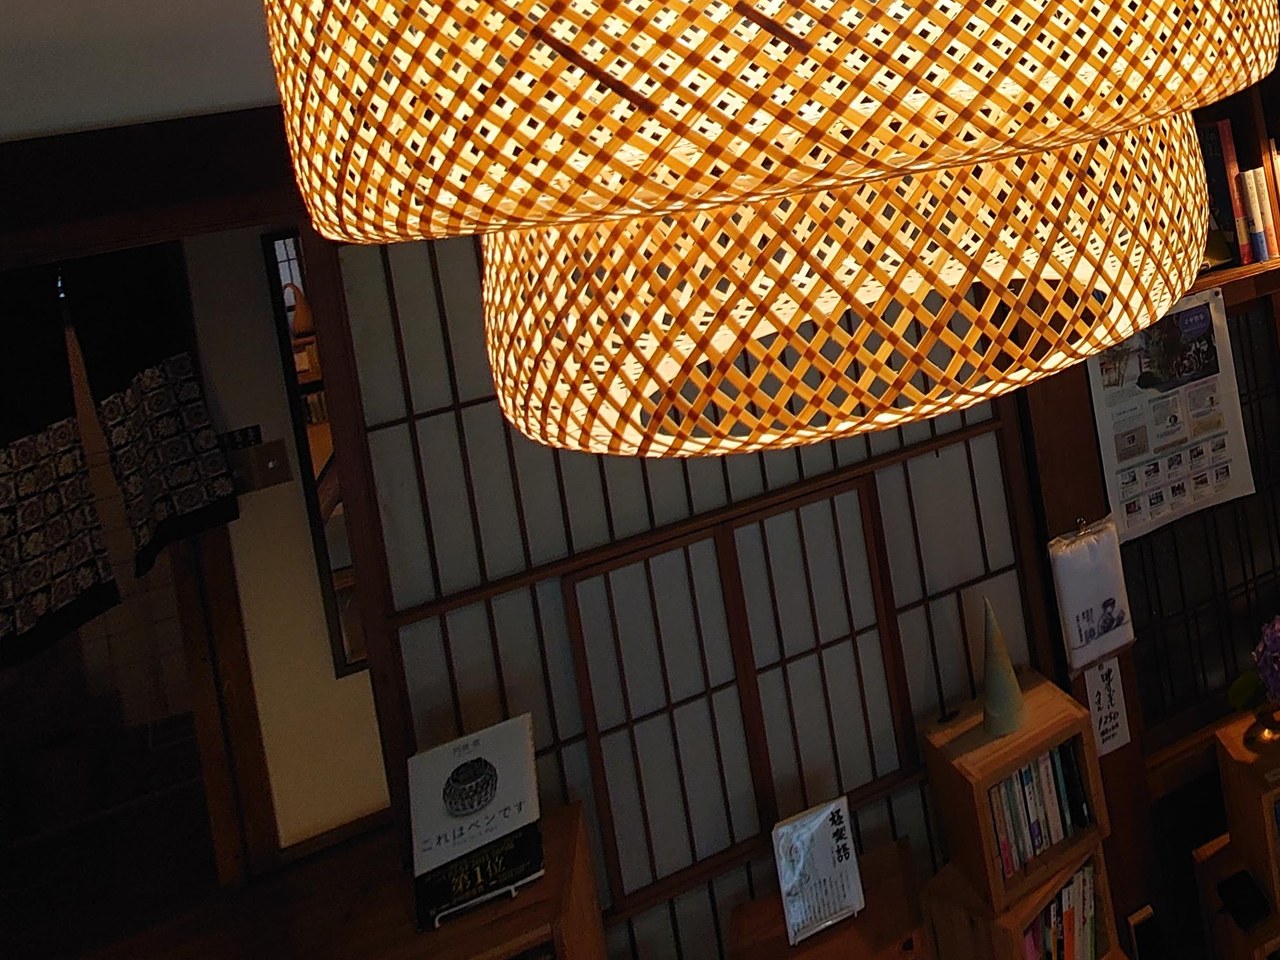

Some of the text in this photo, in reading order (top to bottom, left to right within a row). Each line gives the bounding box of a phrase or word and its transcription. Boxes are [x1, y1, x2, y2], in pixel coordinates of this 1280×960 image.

[421, 801, 526, 853] これはペンです
